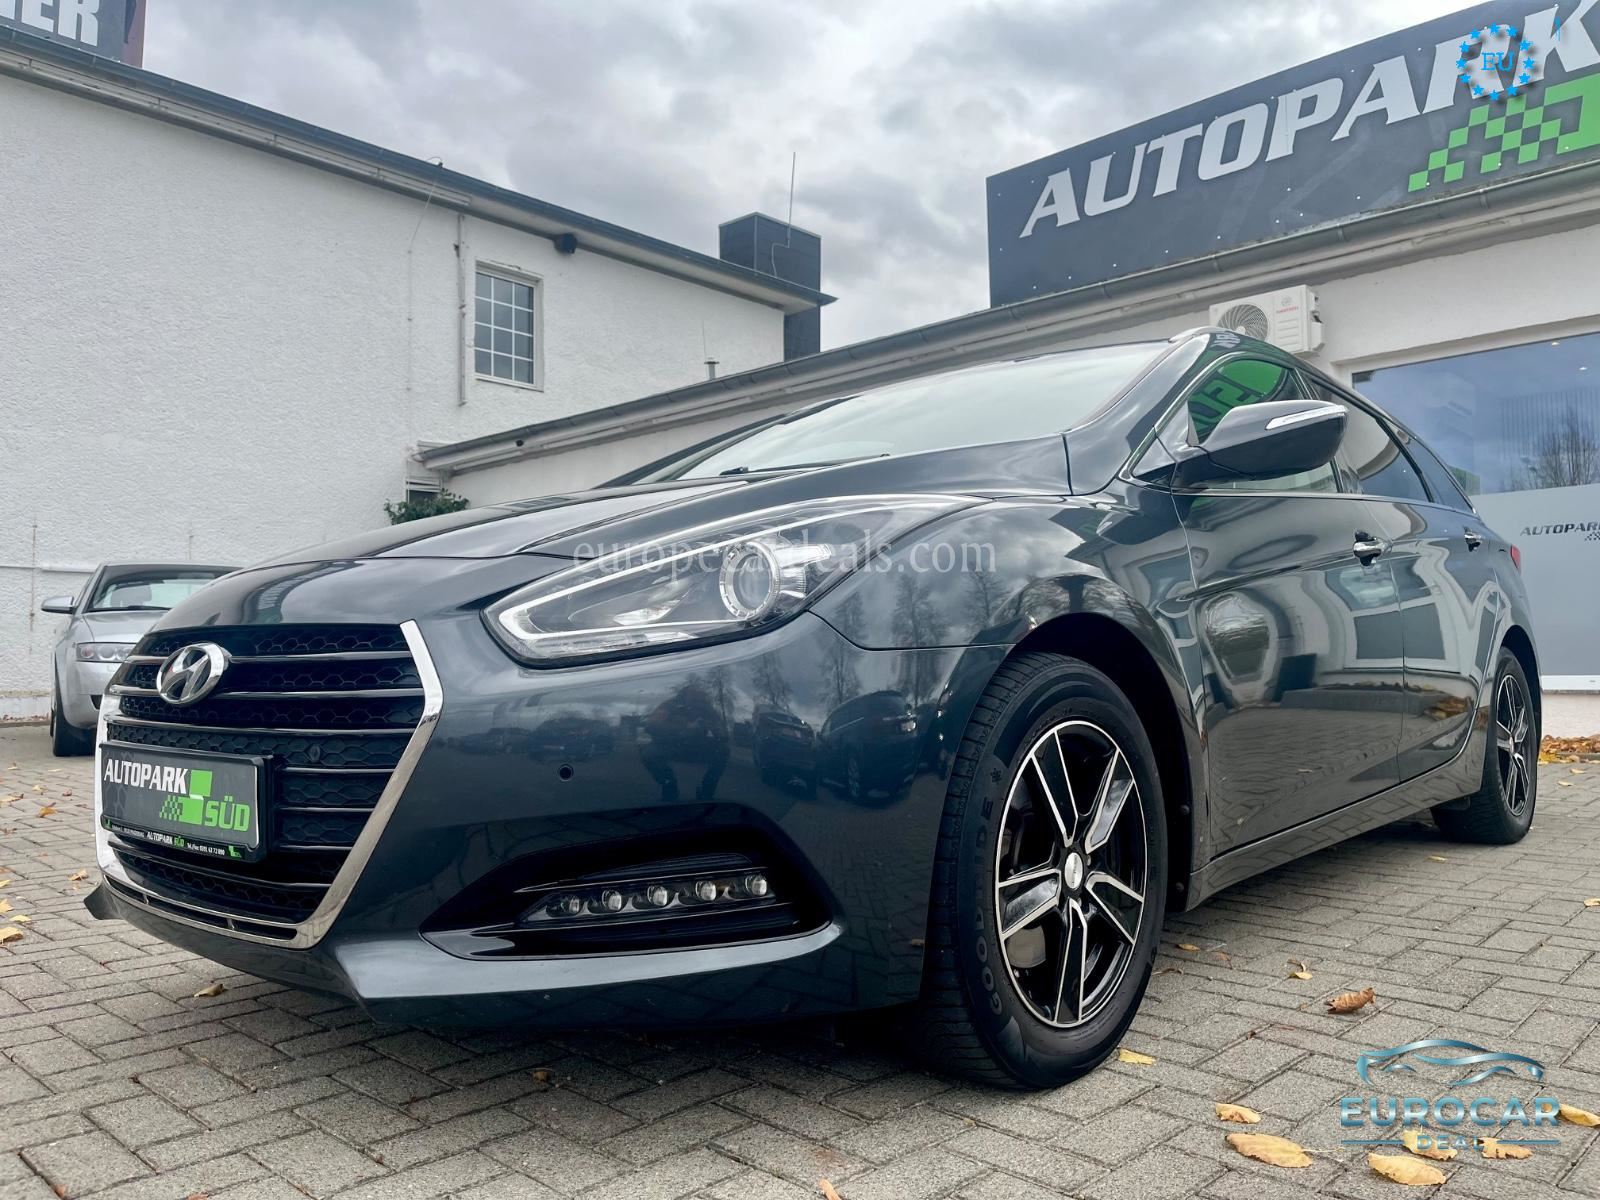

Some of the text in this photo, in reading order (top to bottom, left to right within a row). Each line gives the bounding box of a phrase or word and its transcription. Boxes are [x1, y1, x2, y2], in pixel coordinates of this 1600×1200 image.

[0, 0, 99, 47] ER
[1019, 0, 1600, 238] AUTOPARK
[1520, 521, 1600, 536] AUTOPAR
[104, 759, 188, 795] AUTOPARK
[204, 796, 250, 832] SÜD
[975, 797, 1002, 1015] GOODIDE
